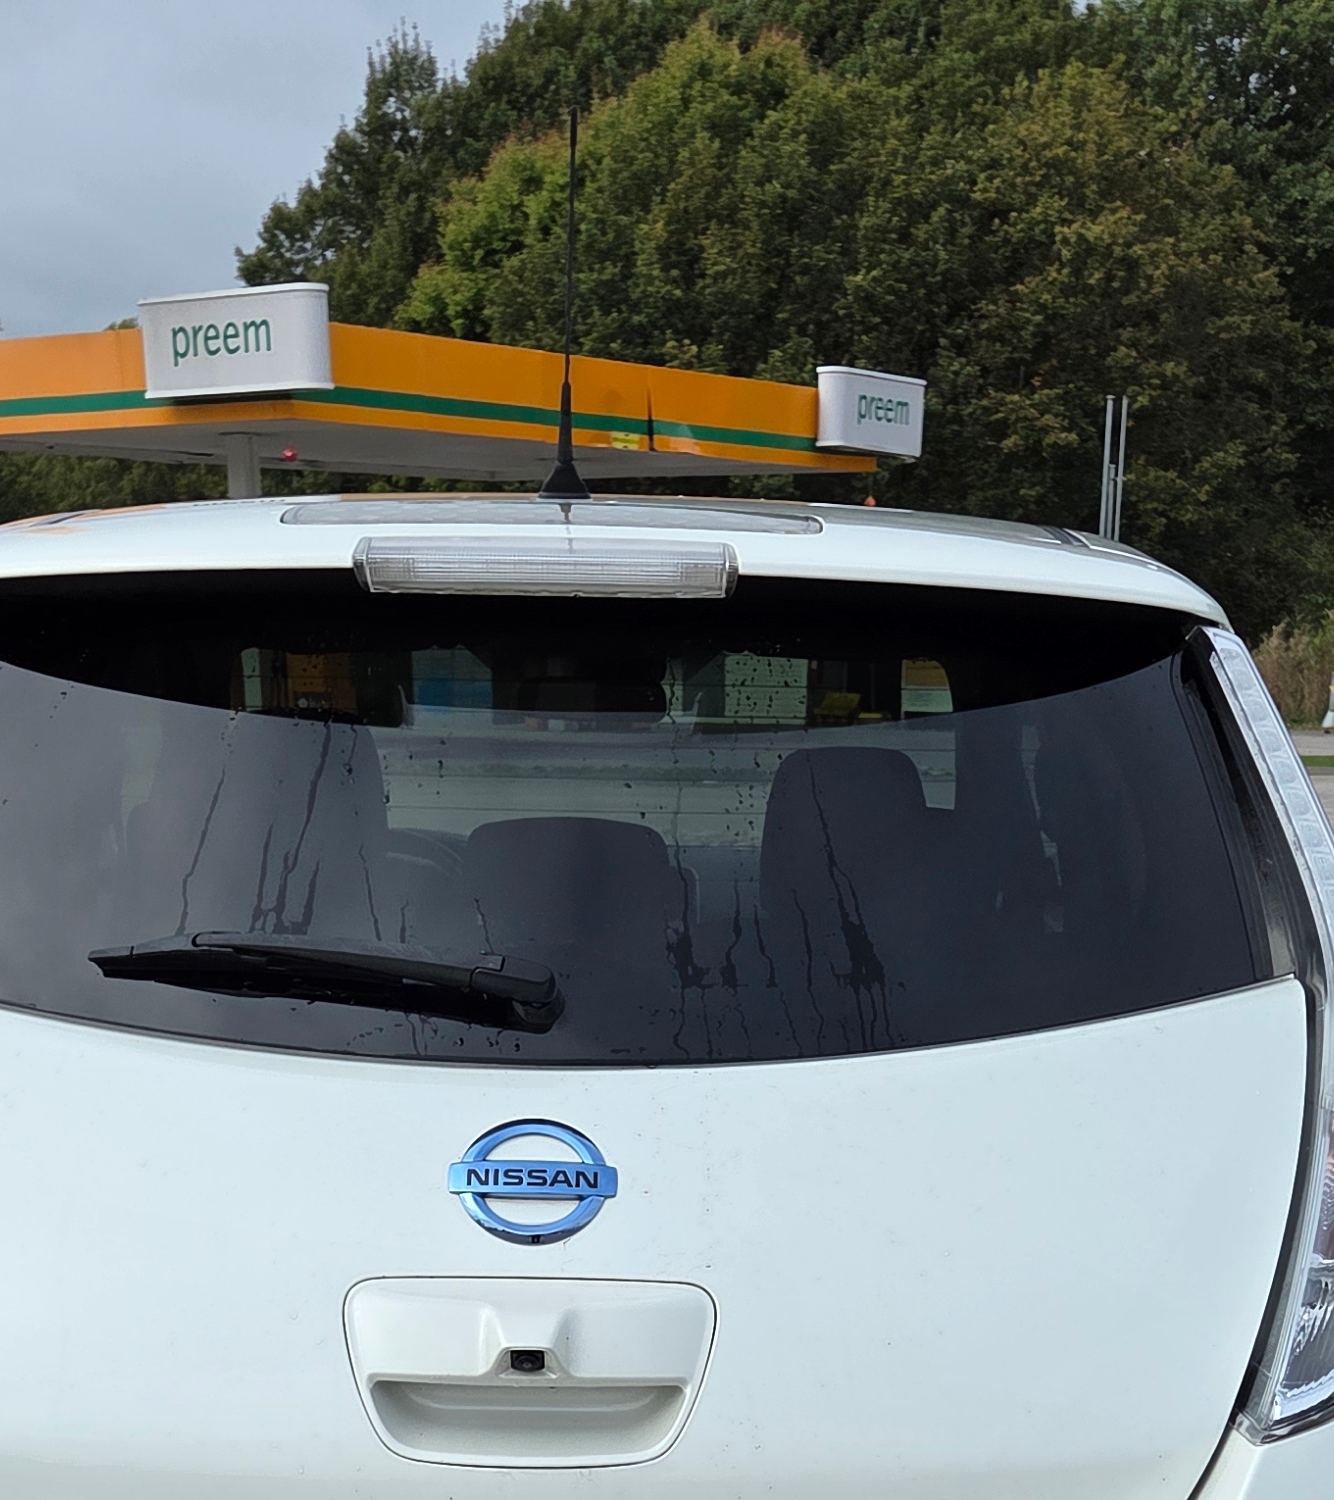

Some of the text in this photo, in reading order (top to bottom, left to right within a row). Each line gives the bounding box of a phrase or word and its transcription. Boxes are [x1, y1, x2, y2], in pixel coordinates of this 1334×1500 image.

[171, 319, 271, 367] preem
[857, 394, 909, 425] preem
[467, 1168, 598, 1188] NISSAN
